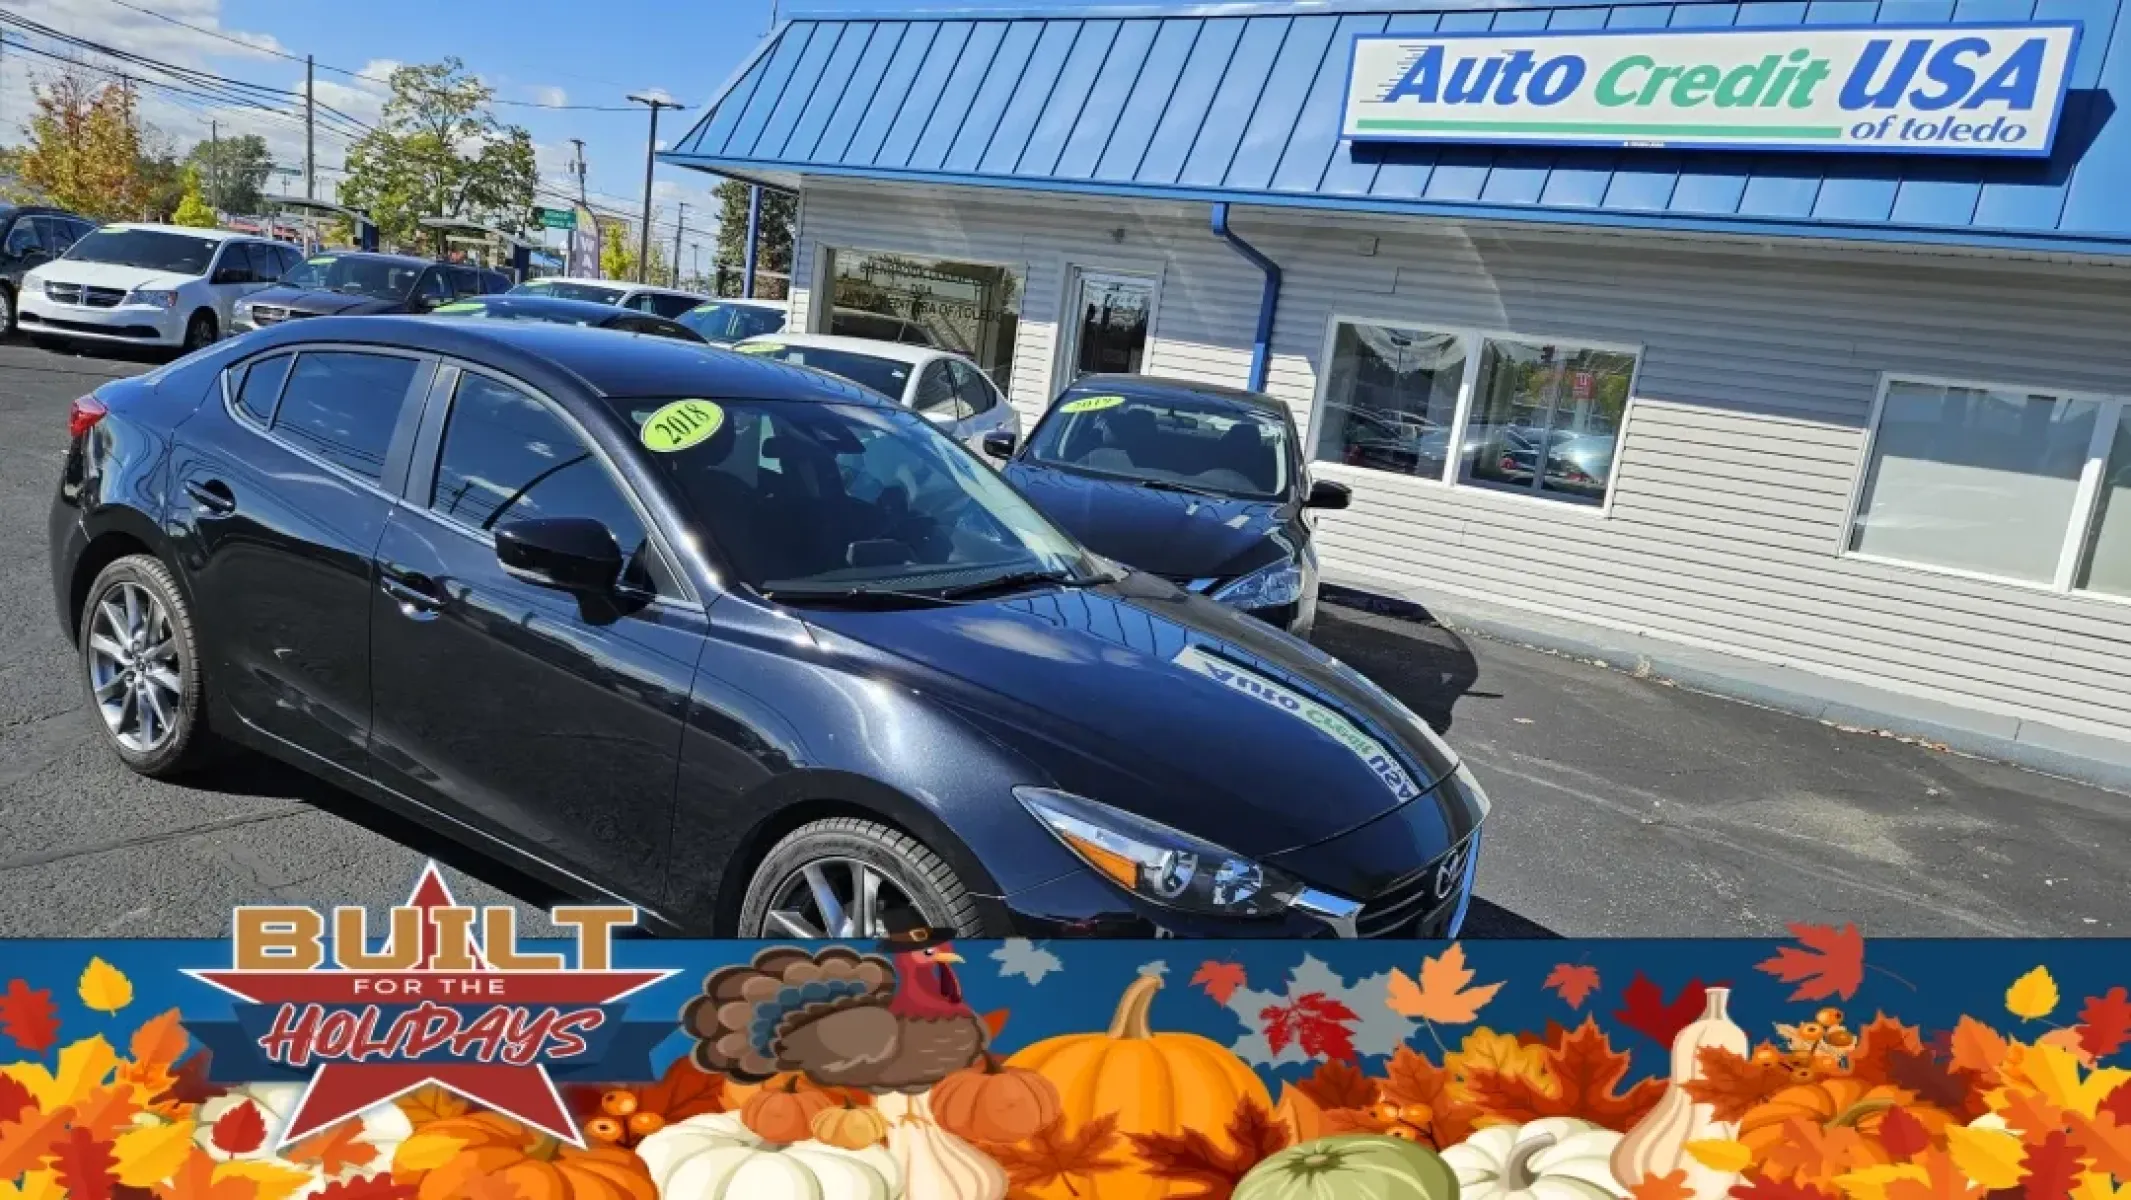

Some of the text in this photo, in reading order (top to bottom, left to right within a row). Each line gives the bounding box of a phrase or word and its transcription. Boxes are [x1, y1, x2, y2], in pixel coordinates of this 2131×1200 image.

[1376, 37, 2048, 111] Auto Credit USA
[1850, 115, 2027, 142] of toledo
[655, 403, 711, 445] 2018
